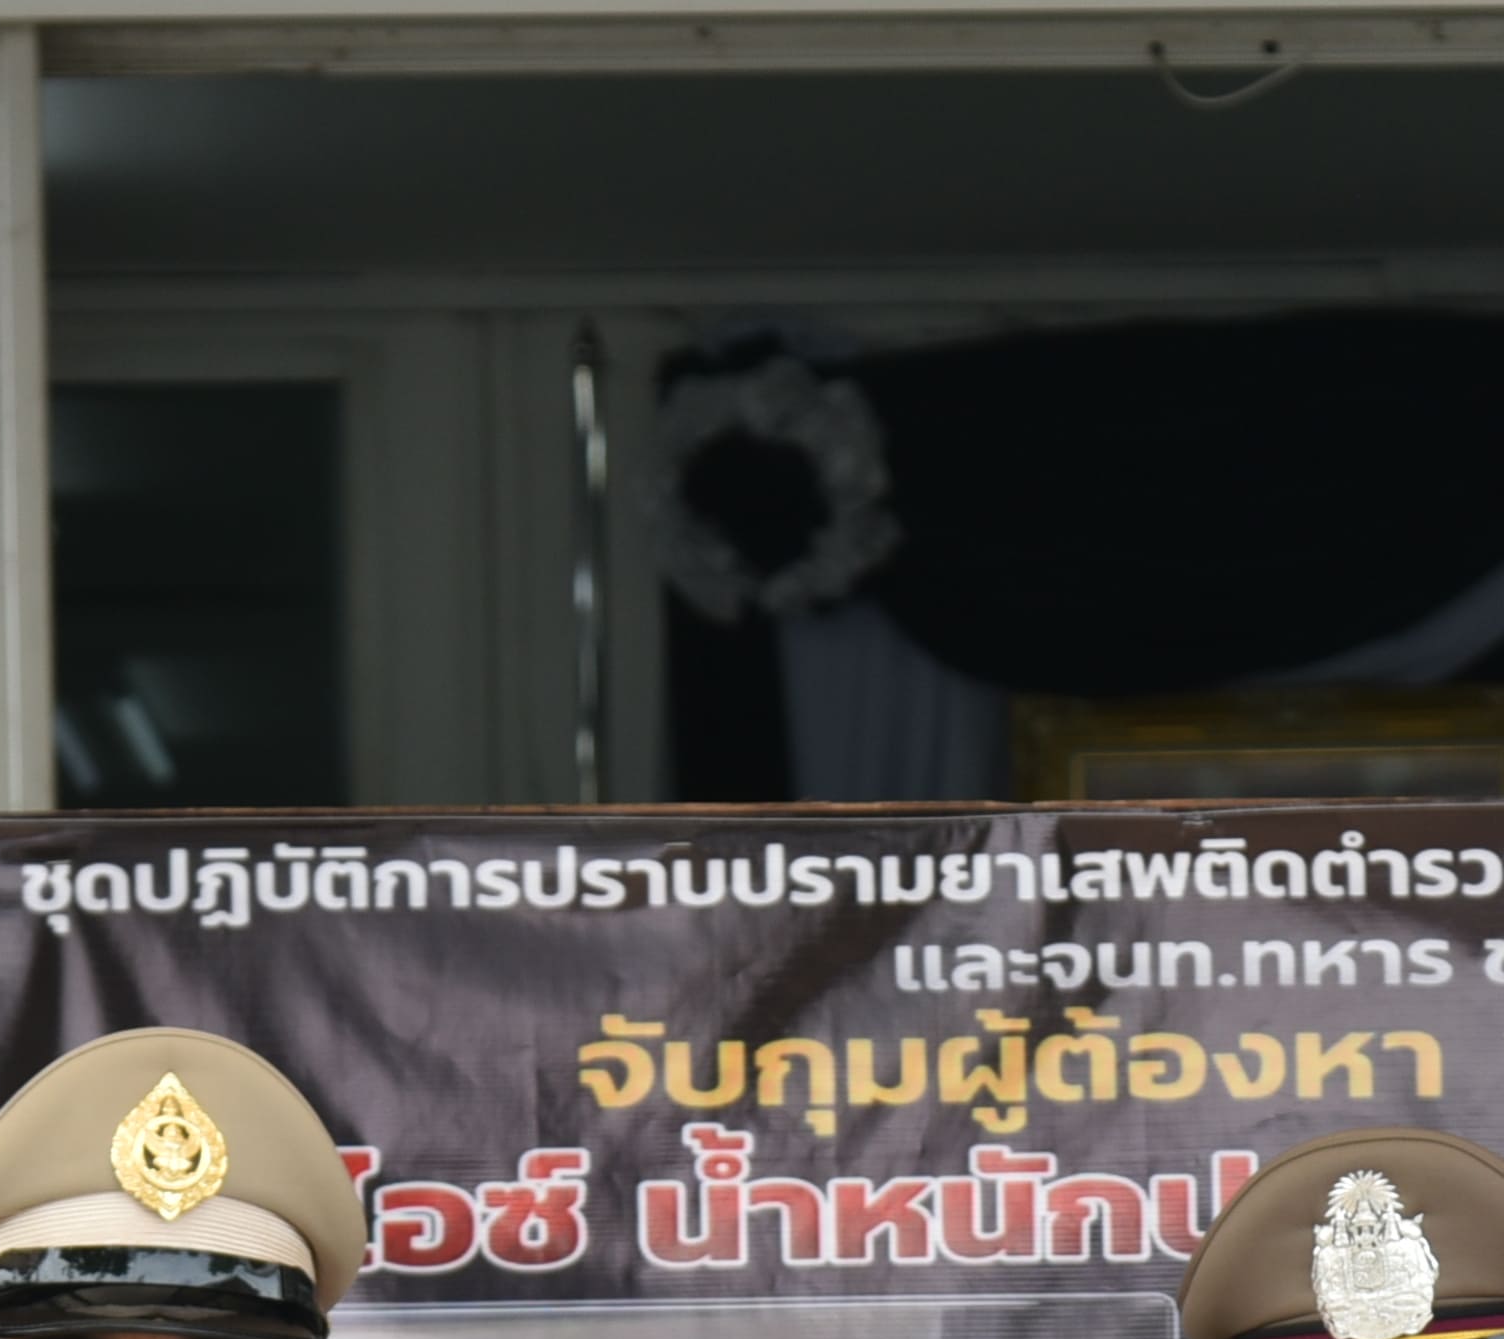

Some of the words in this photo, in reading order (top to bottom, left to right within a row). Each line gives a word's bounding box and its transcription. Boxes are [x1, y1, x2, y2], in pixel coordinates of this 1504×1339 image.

[895, 934, 1455, 992] และจนท.ทหาร
[576, 1002, 1444, 1138] จับกุมผู้ต้องหา
